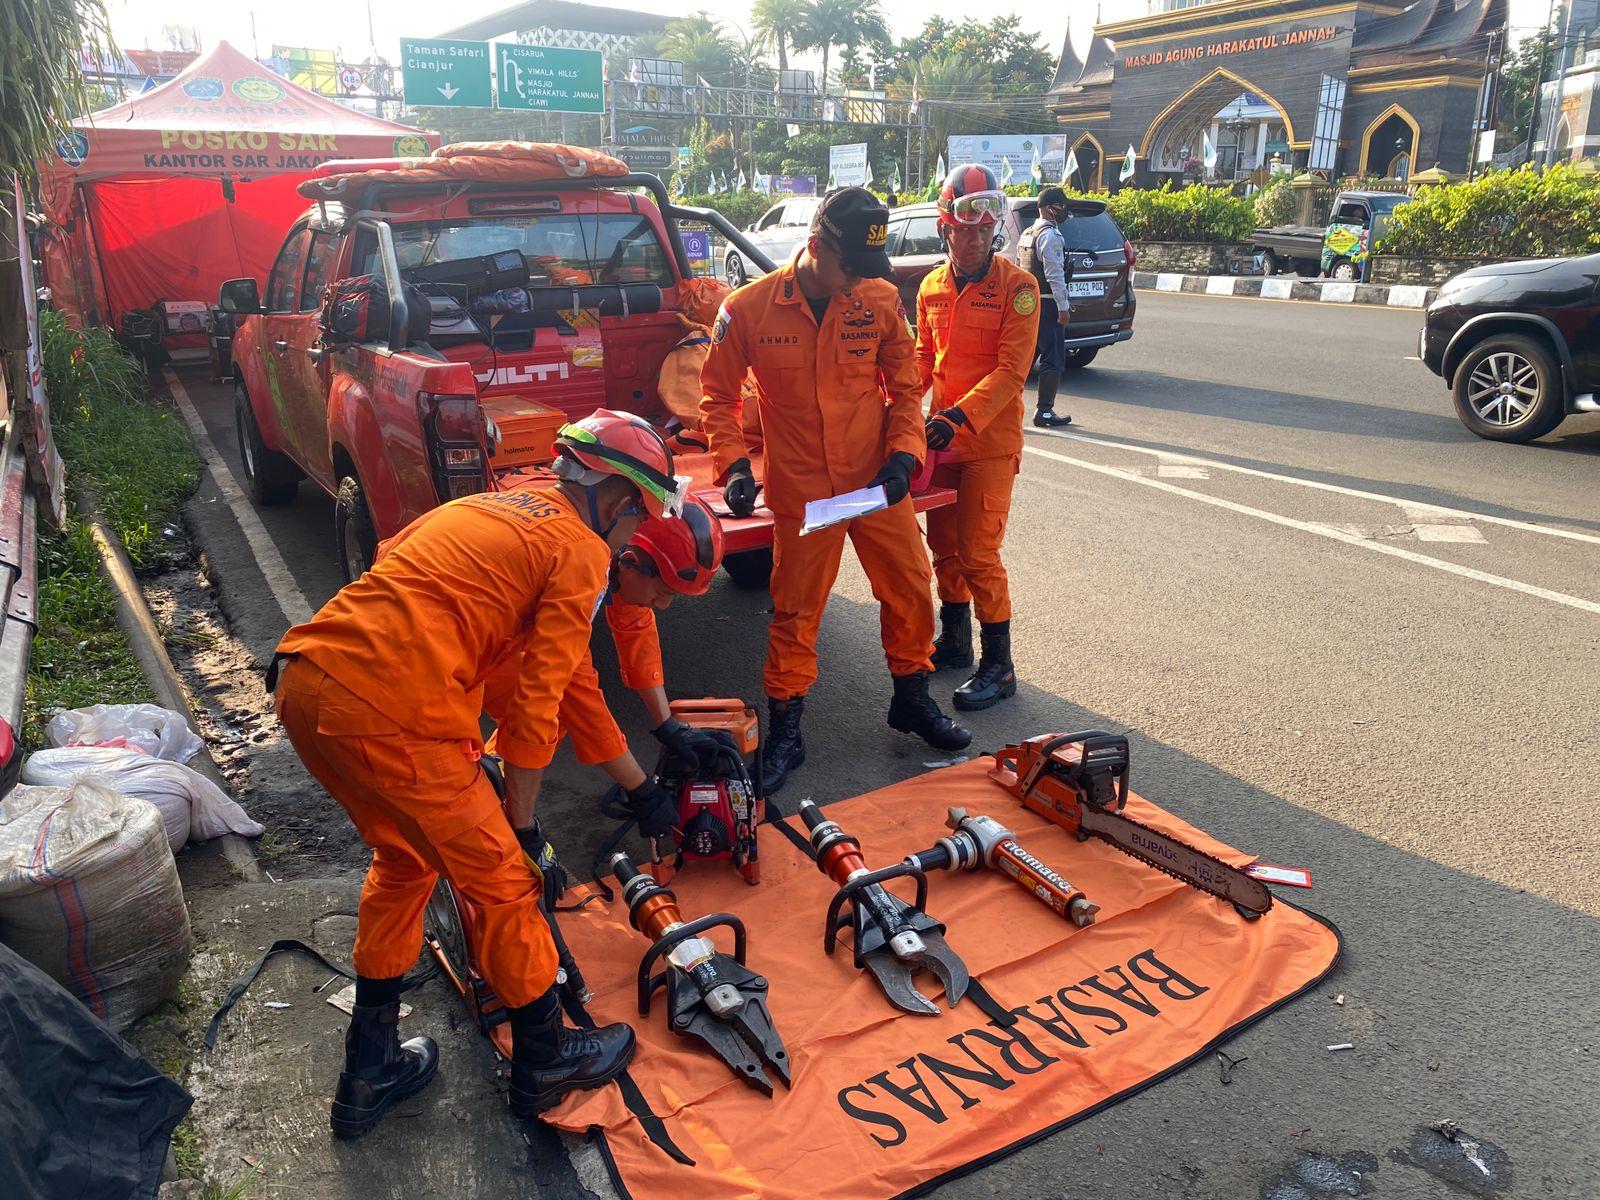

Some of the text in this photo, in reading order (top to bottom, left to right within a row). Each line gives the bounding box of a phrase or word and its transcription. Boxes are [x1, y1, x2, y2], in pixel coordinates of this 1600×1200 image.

[406, 44, 484, 58] Taman Safari
[1125, 26, 1337, 68] MASJID AGUNG HARAKATUL JANNAH
[513, 49, 544, 58] CISARUA
[408, 59, 454, 72] Cianjur
[527, 67, 577, 78] VIMALA HILLS
[527, 80, 552, 88] MASJID
[528, 89, 599, 99] HARAKATUL JANNAH
[173, 106, 309, 116] BASARNAS
[161, 130, 339, 151] POSKO SAR
[144, 153, 354, 168] KANTOR SAR JAKA
[1075, 282, 1089, 291] 1441
[970, 301, 1001, 310] BASARNAS
[759, 335, 798, 344] AHMAD
[841, 331, 878, 341] BASARNAS
[504, 445, 535, 455] holmatro
[837, 948, 1210, 1150] BASARNAS
